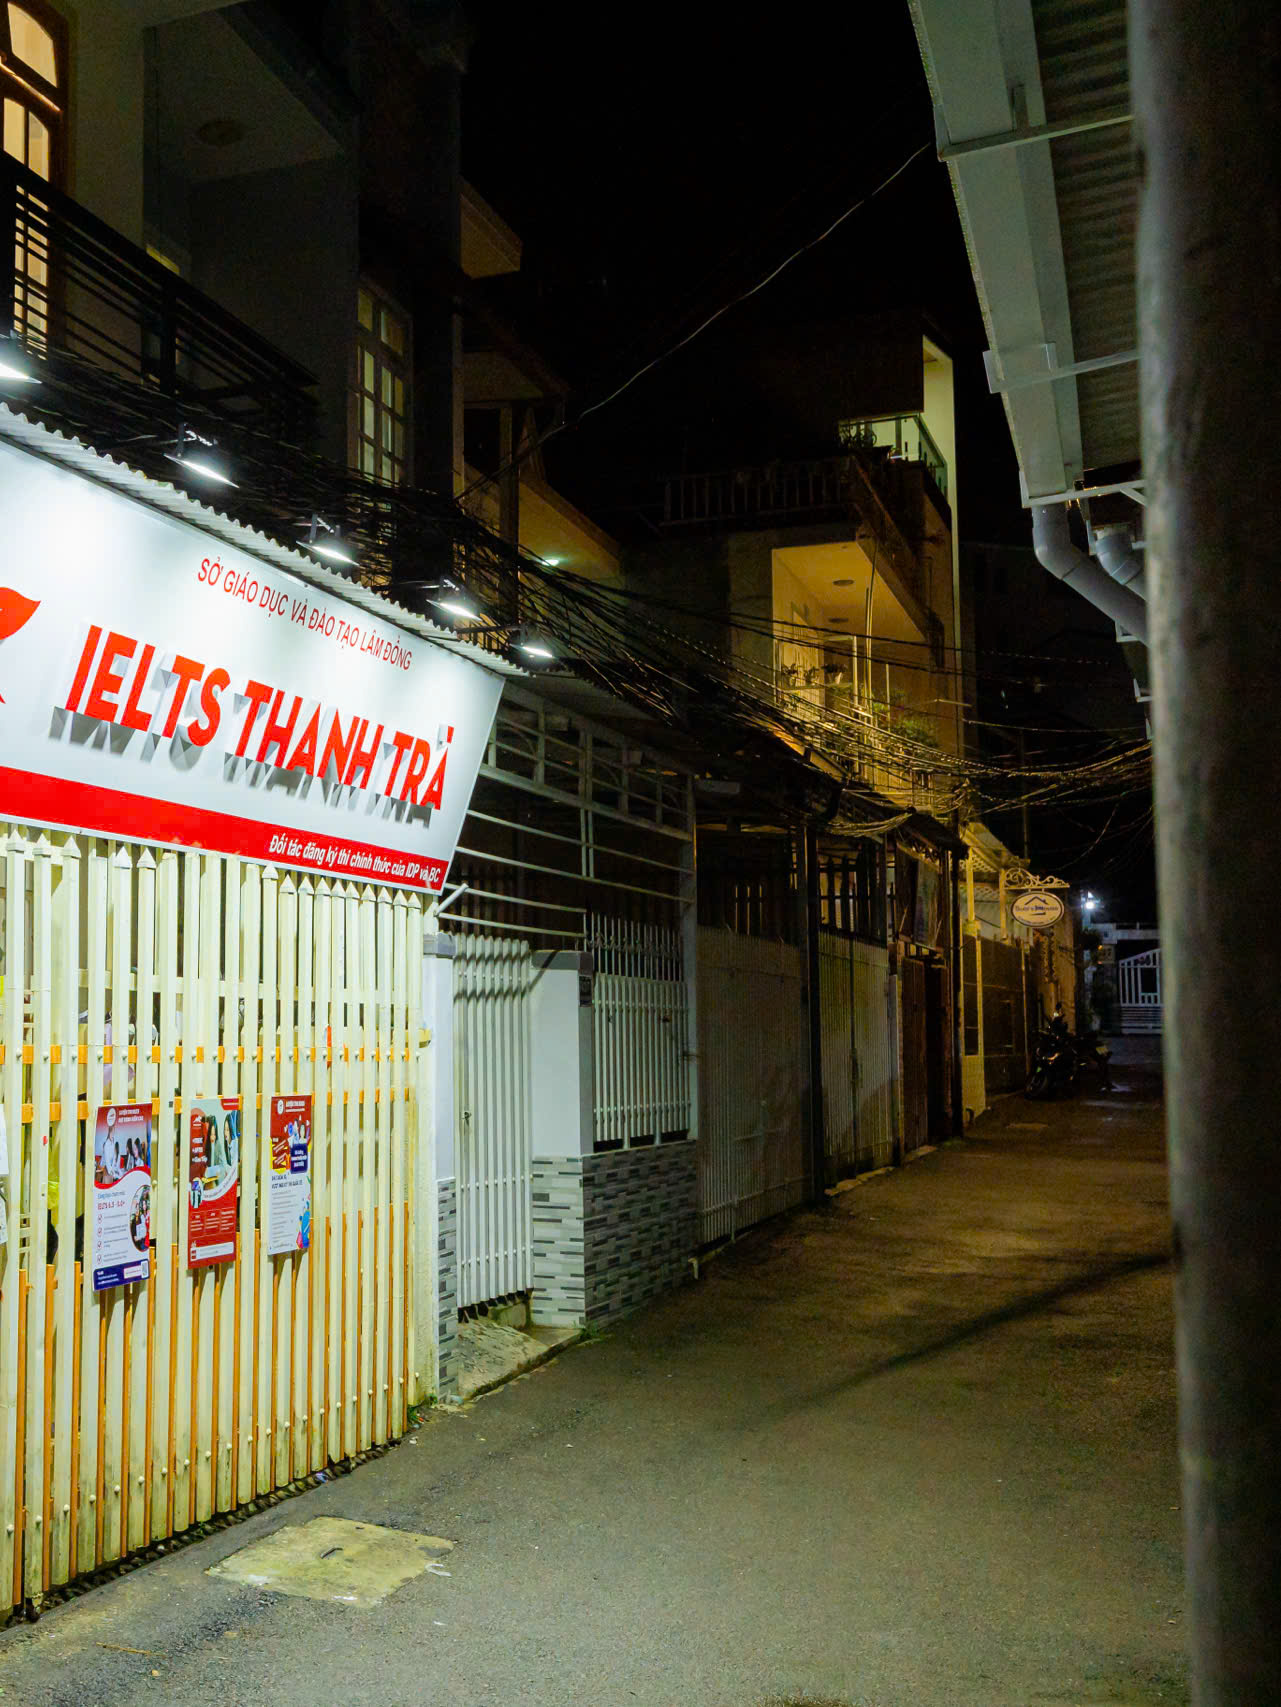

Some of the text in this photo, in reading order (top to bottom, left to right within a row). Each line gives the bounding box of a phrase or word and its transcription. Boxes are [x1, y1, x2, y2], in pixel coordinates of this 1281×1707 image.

[197, 556, 412, 670] SỞ GIÁO DỤC VÀ ĐÀO TẠO LÂM ĐỒNG
[64, 624, 231, 747] IELTS
[235, 679, 384, 790] THANH
[269, 832, 289, 854] Đối
[287, 838, 303, 857] tác
[303, 842, 326, 865] đăng
[325, 846, 339, 867] ký
[337, 849, 351, 866] thi
[350, 851, 373, 870] chính
[373, 856, 392, 874] thức
[391, 860, 406, 876] của
[405, 862, 420, 878] IDP
